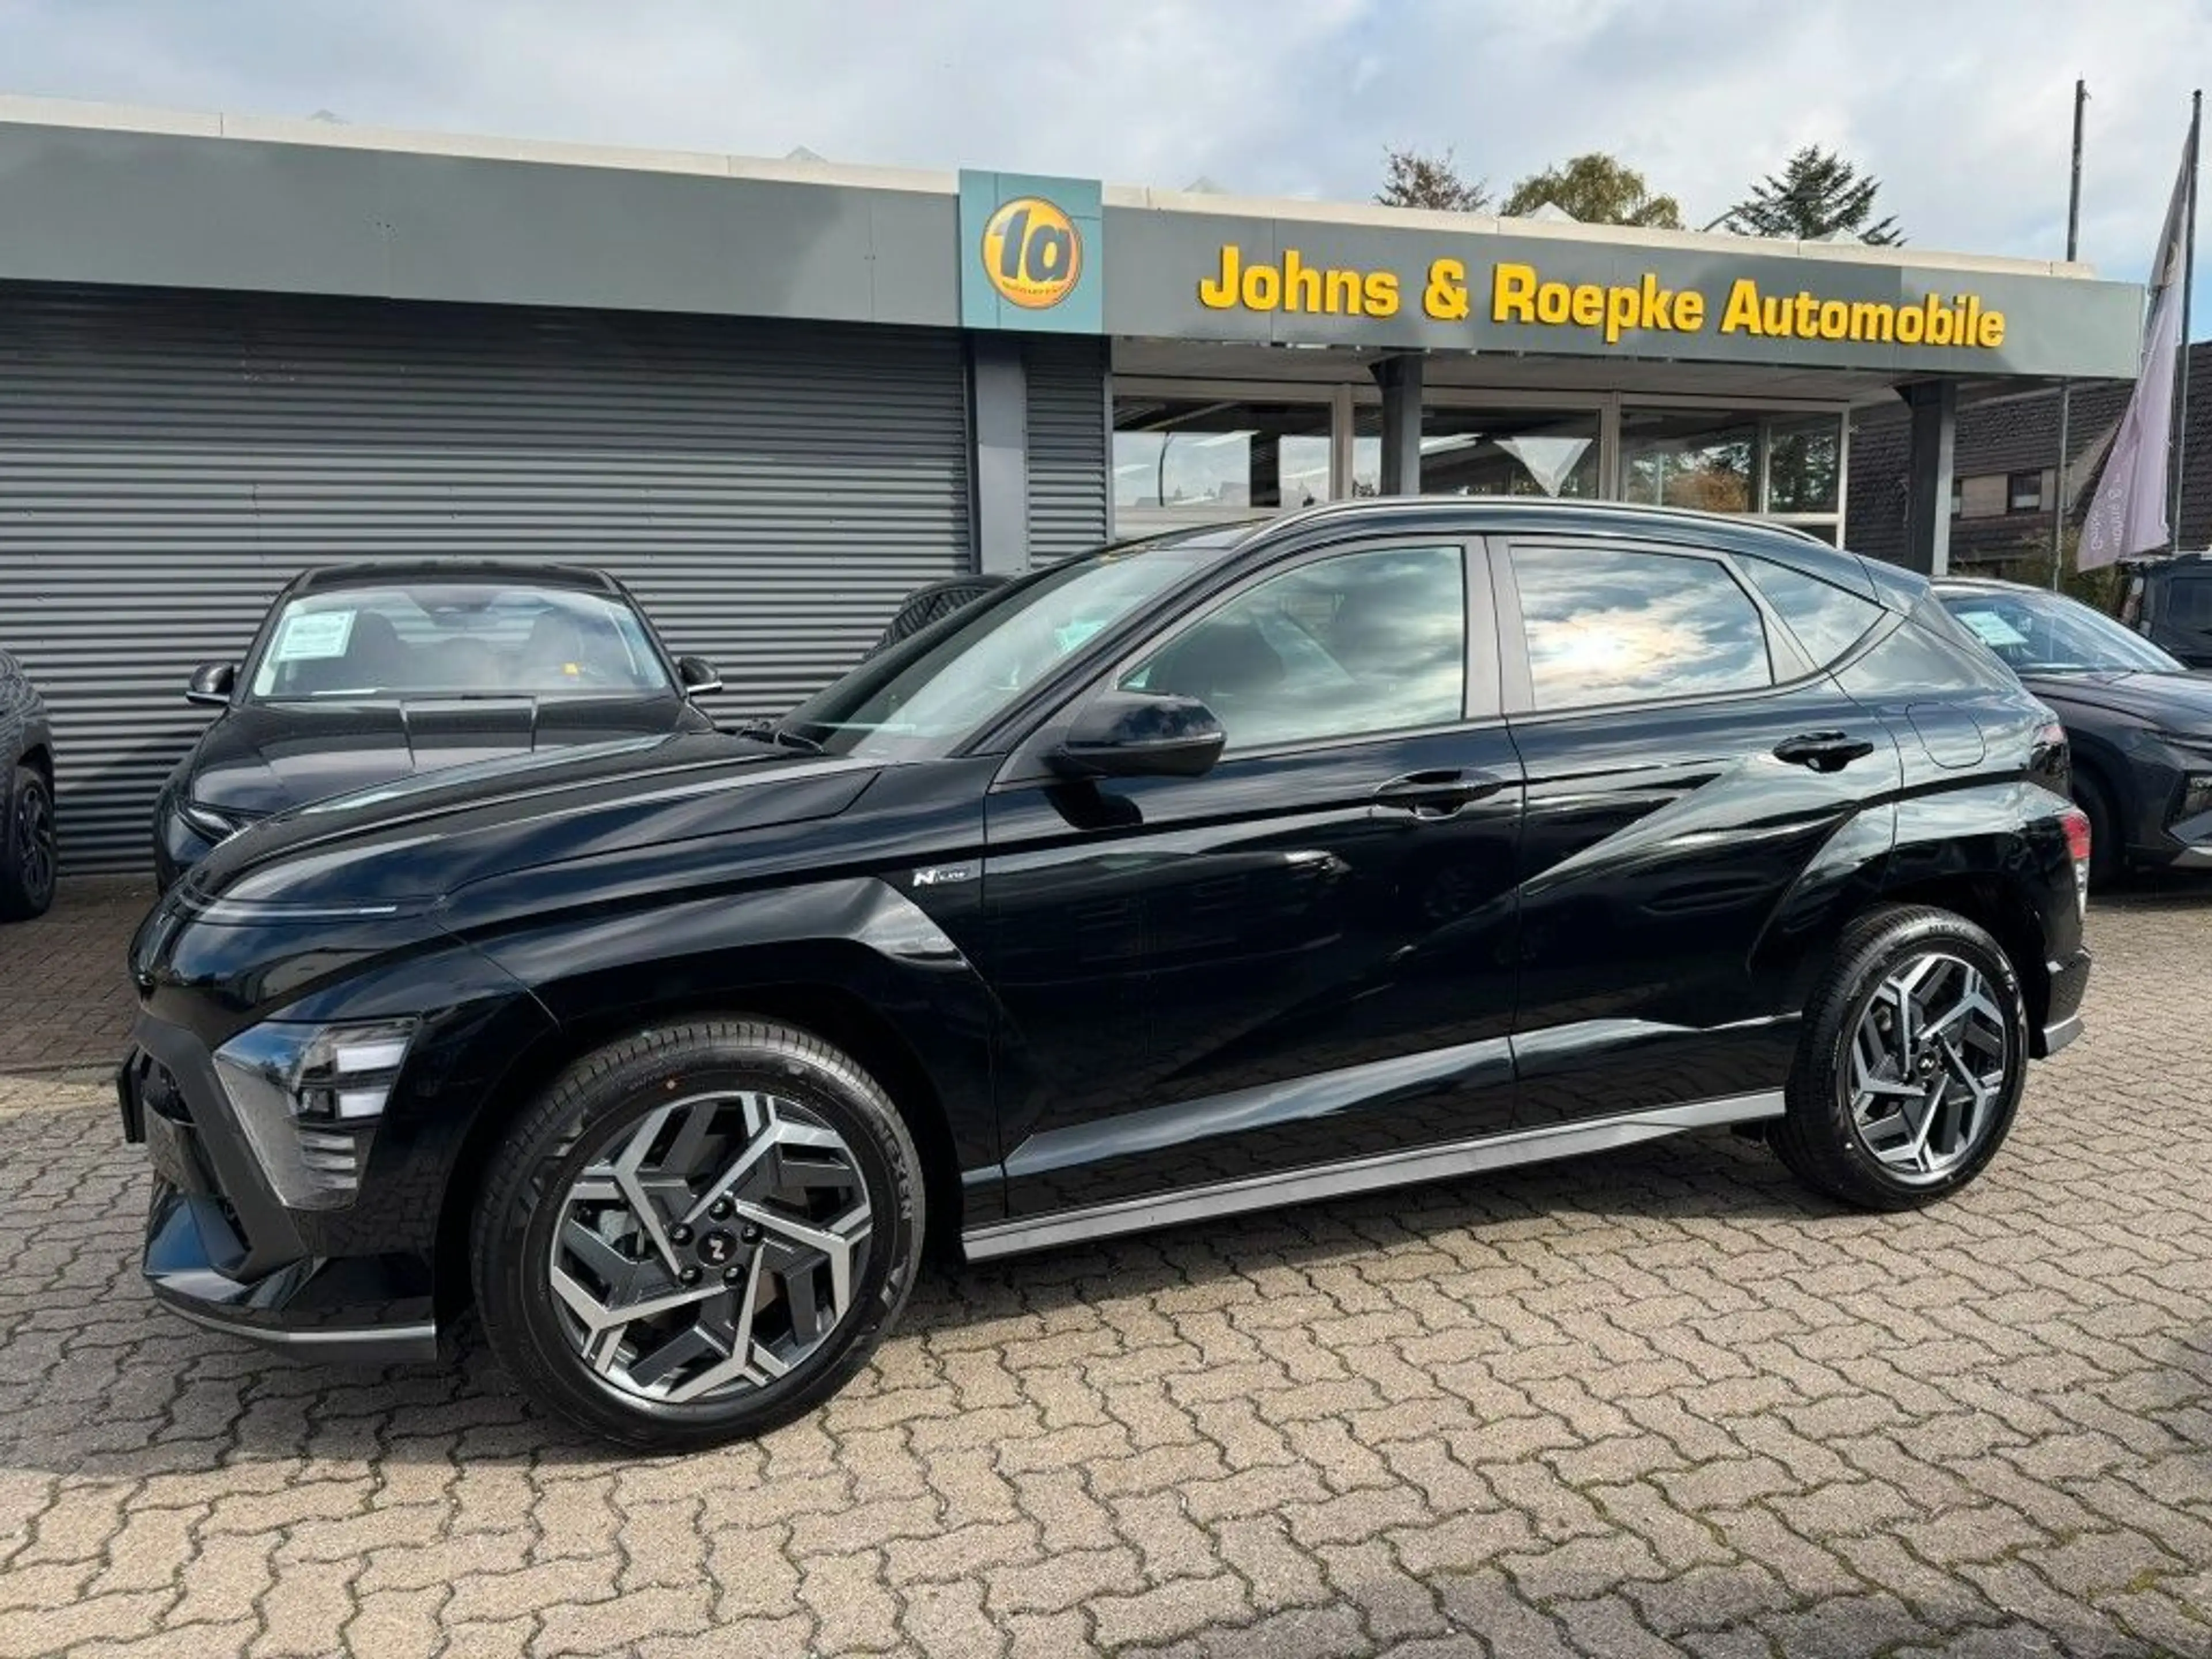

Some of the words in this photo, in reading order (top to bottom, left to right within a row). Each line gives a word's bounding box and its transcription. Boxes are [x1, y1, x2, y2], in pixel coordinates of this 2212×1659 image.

[991, 208, 1072, 282] 1a
[1199, 246, 1399, 319] Johns
[1425, 259, 1469, 319] &
[1493, 263, 1704, 343] Roepke
[1721, 280, 2004, 347] Automobile
